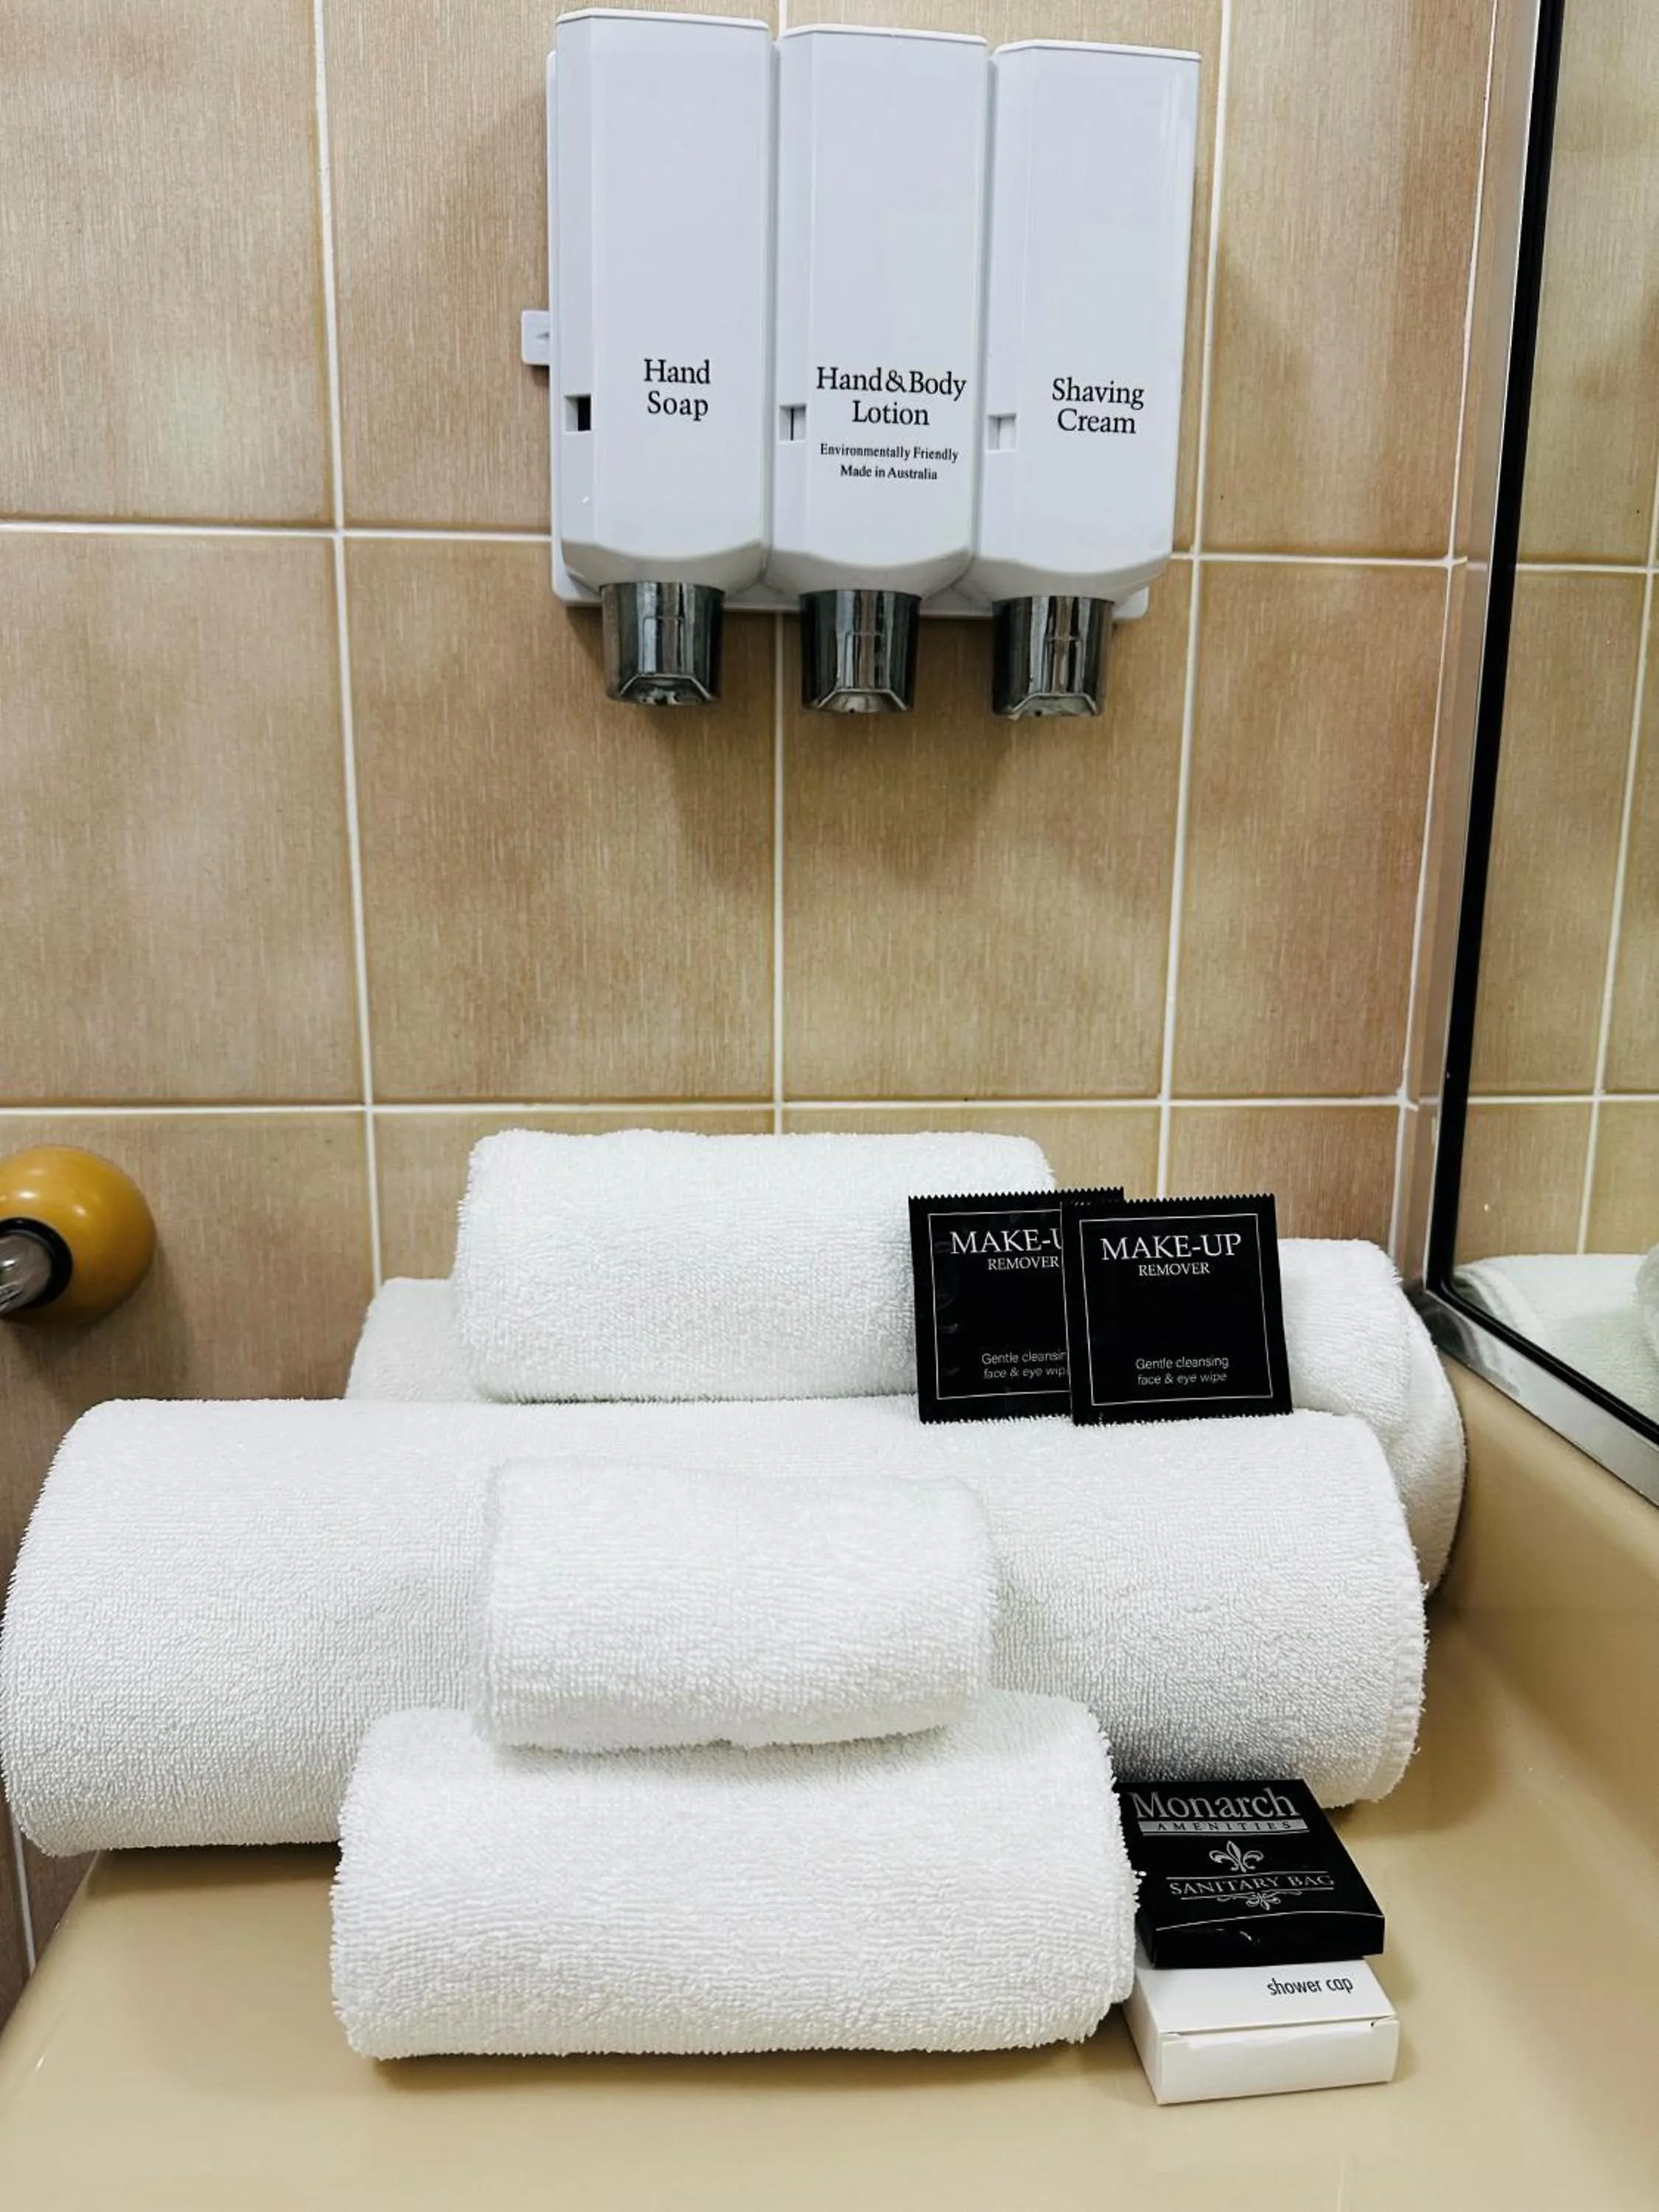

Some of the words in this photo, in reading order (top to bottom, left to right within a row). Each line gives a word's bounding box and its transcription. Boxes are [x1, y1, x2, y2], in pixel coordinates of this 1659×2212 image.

[643, 358, 711, 385] Hand
[816, 366, 967, 400] Hand&Body
[1051, 377, 1144, 410] Shaving
[647, 390, 709, 421] Soap
[852, 400, 930, 427] Lotion
[1057, 408, 1136, 434] Cream
[820, 442, 911, 460] Environmentally
[913, 445, 959, 464] Friendly
[840, 465, 873, 479] Made
[874, 466, 886, 479] in
[887, 466, 938, 481] Australia
[950, 1228, 1062, 1253] MAKE-U
[1100, 1234, 1242, 1260] MAKE-UP
[987, 1256, 1060, 1270] REMOVER
[1138, 1262, 1211, 1276] REMOVER
[981, 1352, 1018, 1365] Gentle
[1021, 1349, 1067, 1363] cleansin
[1135, 1357, 1173, 1370] Gentle
[1175, 1355, 1229, 1369] cleansing
[983, 1368, 1007, 1380] face
[1009, 1366, 1019, 1377] &
[1023, 1368, 1043, 1380] eye
[1045, 1366, 1069, 1378] wip
[1138, 1373, 1161, 1385] face
[1164, 1372, 1174, 1384] &
[1177, 1374, 1197, 1385] eye
[1200, 1371, 1227, 1384] wipe
[1130, 1787, 1299, 1818] Monarch
[1158, 1820, 1292, 1831] AMENITIES
[1169, 1876, 1279, 1895] SANITARY
[1289, 1874, 1335, 1886] BAG
[1267, 1978, 1321, 1995] shower
[1326, 1977, 1353, 1994] cap
